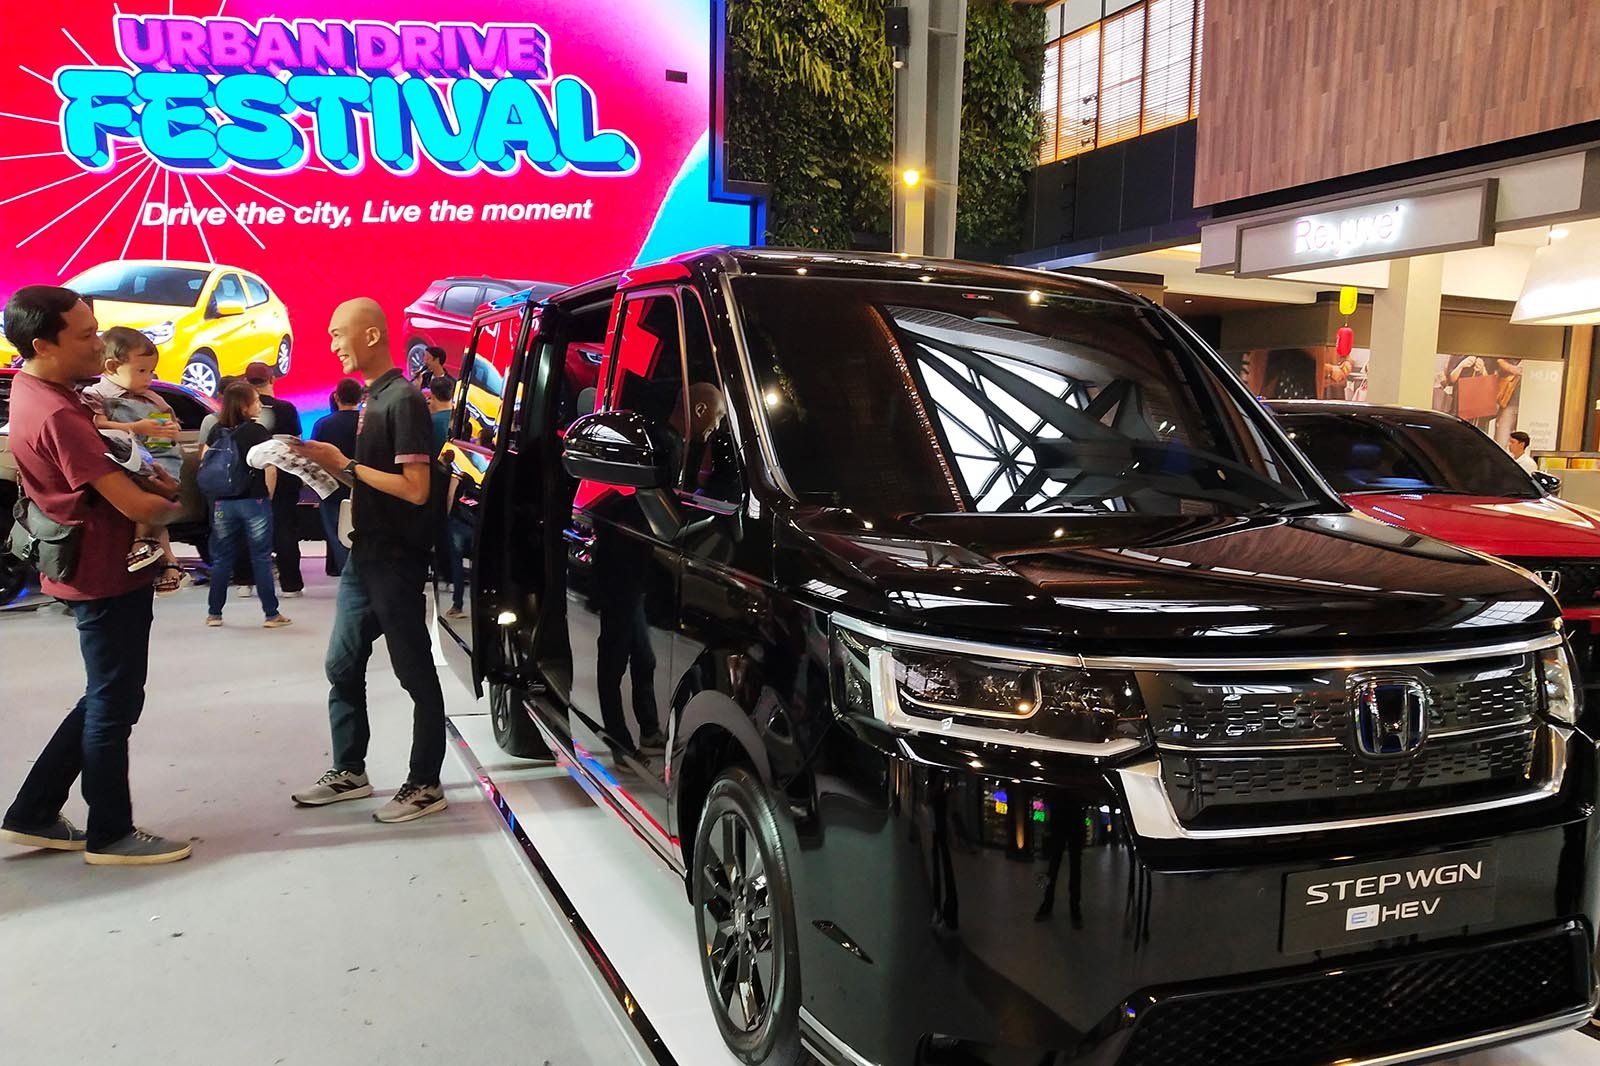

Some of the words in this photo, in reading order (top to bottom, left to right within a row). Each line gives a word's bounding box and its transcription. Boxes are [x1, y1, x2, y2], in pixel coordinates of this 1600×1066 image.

[116, 17, 354, 75] URBAN
[352, 21, 548, 80] DRIVE
[55, 67, 638, 174] FESTIVAL
[141, 202, 227, 226] Drive
[235, 201, 286, 224] the
[294, 201, 352, 229] city,
[362, 200, 421, 223] Live
[429, 200, 474, 222] the
[481, 199, 593, 221] moment
[1306, 873, 1401, 906] STEP
[1405, 860, 1483, 890] WGN
